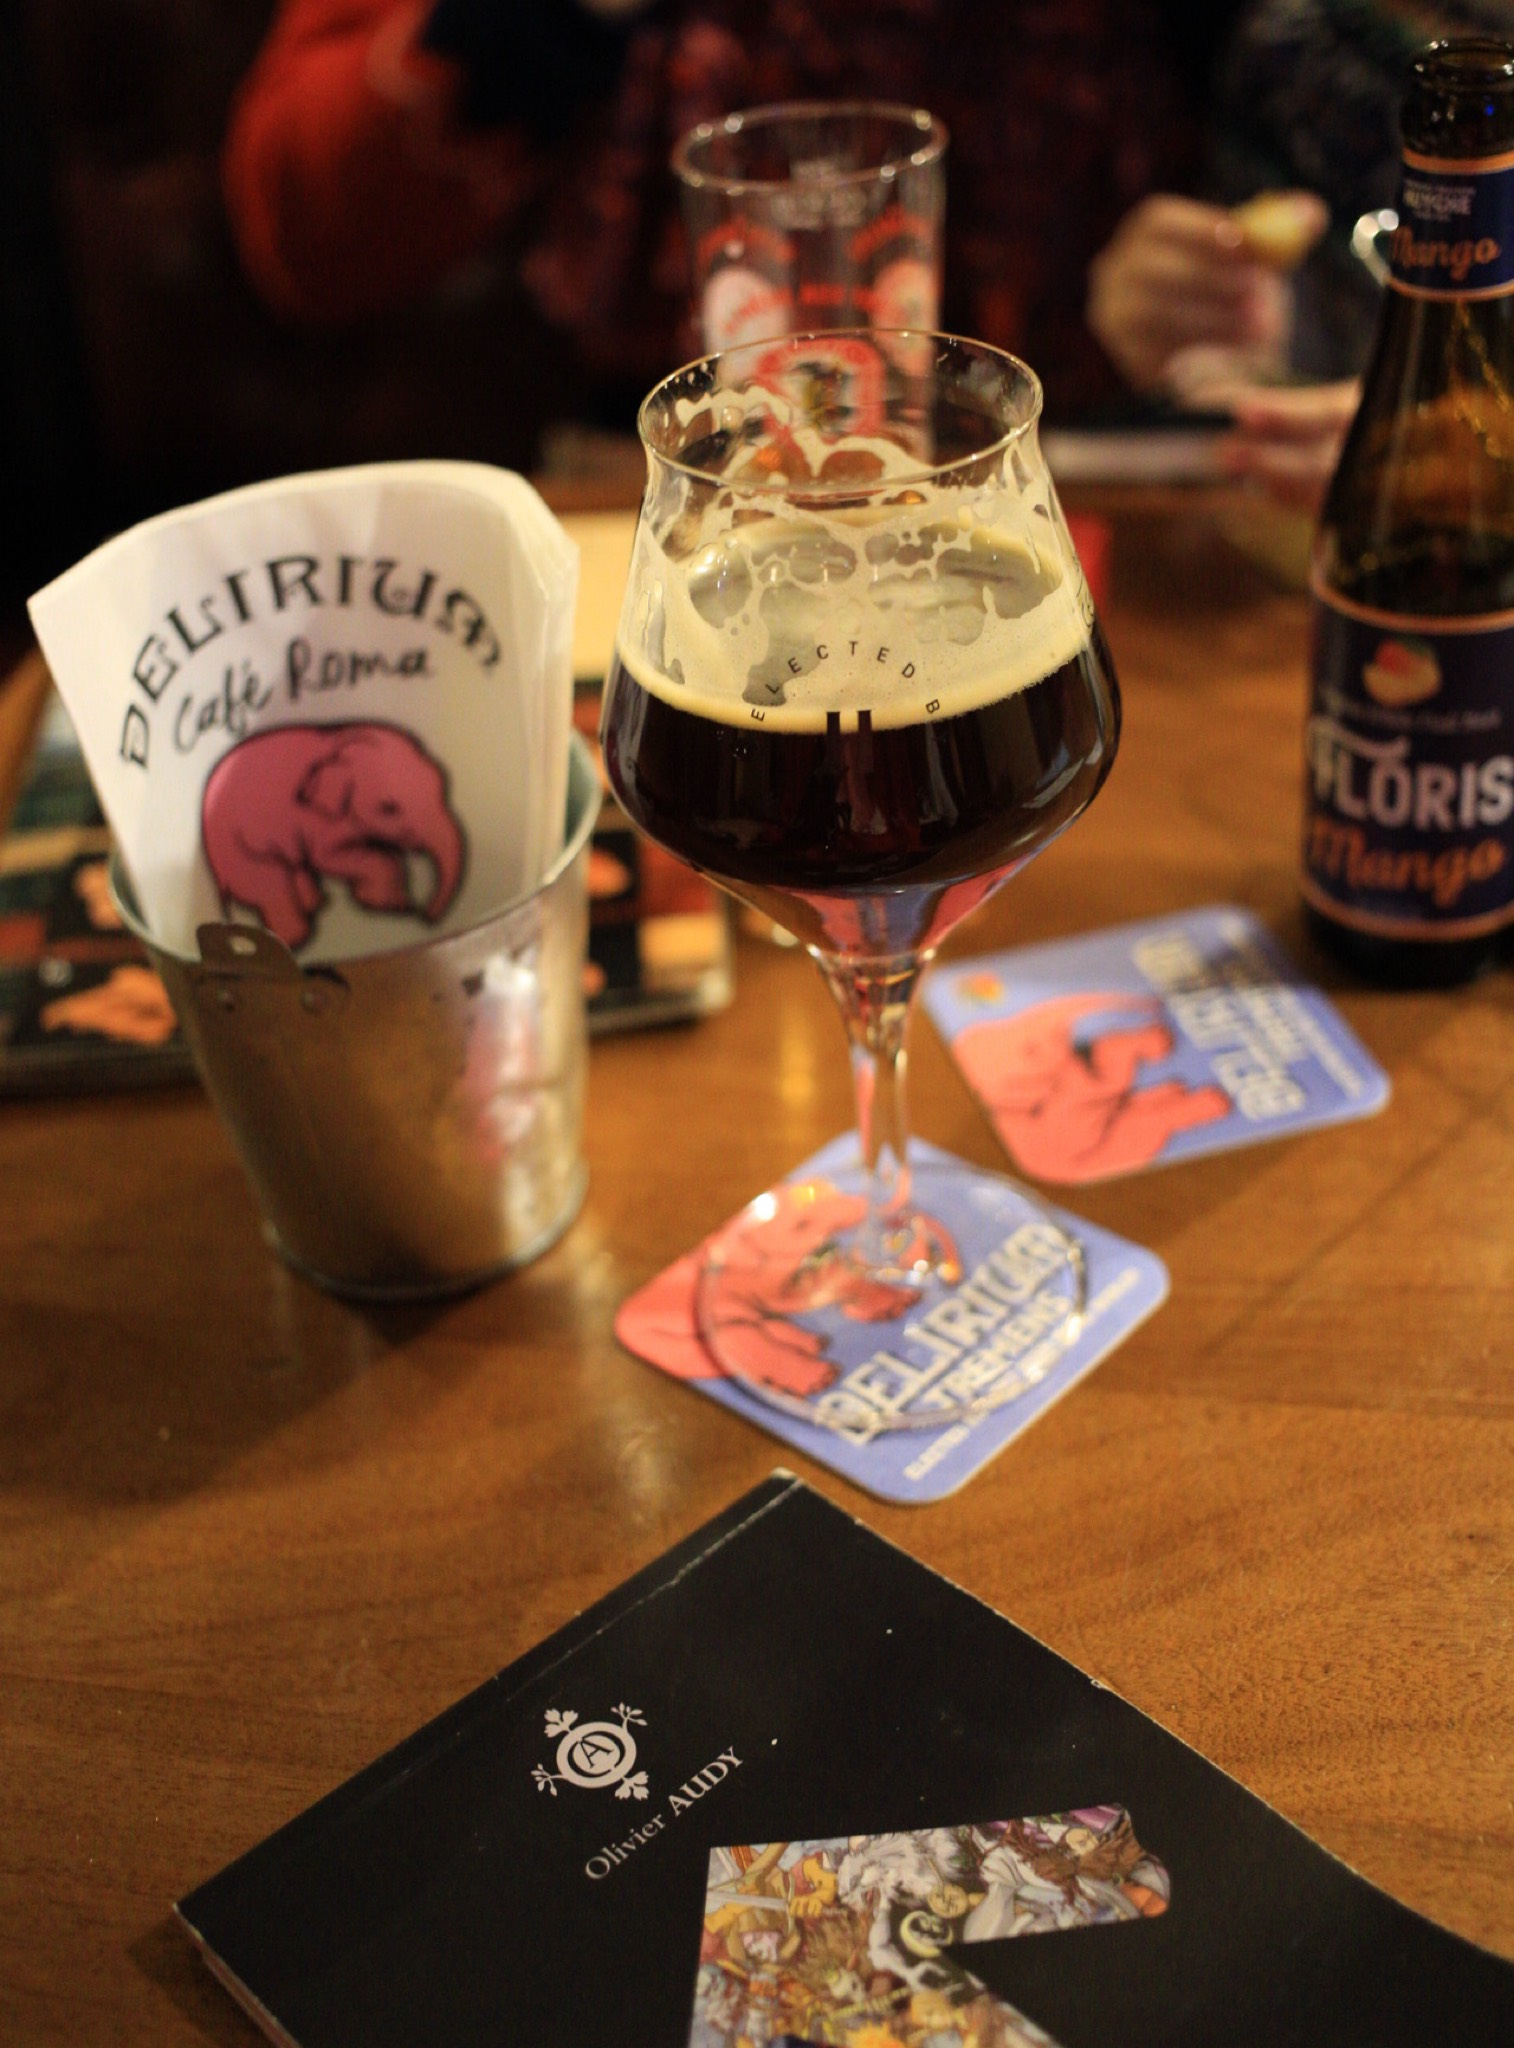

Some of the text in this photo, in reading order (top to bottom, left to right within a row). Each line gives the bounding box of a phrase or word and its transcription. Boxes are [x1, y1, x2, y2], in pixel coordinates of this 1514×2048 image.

[119, 554, 502, 769] DELIRIUM
[175, 636, 428, 755] Café Roma
[584, 1745, 744, 1880] Olivier AUDY
